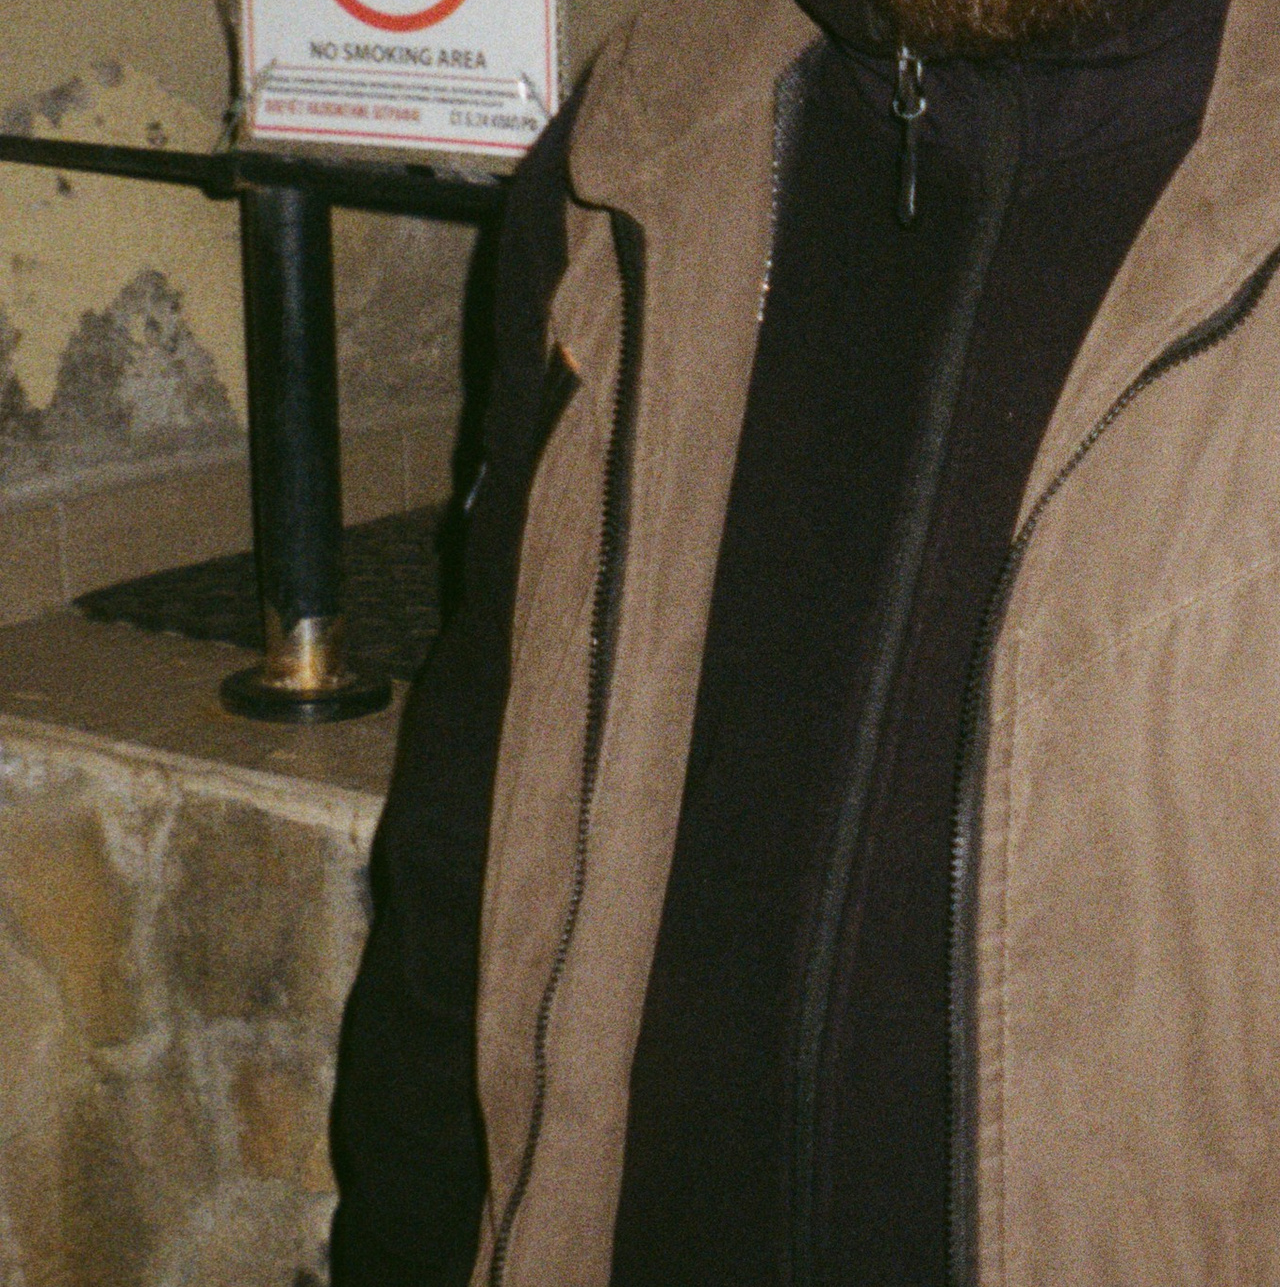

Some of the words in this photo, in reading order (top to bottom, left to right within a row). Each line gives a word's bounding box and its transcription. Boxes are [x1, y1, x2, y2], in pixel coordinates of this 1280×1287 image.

[309, 41, 339, 60] NO
[342, 43, 433, 66] SMOKING
[437, 49, 486, 69] AREA
